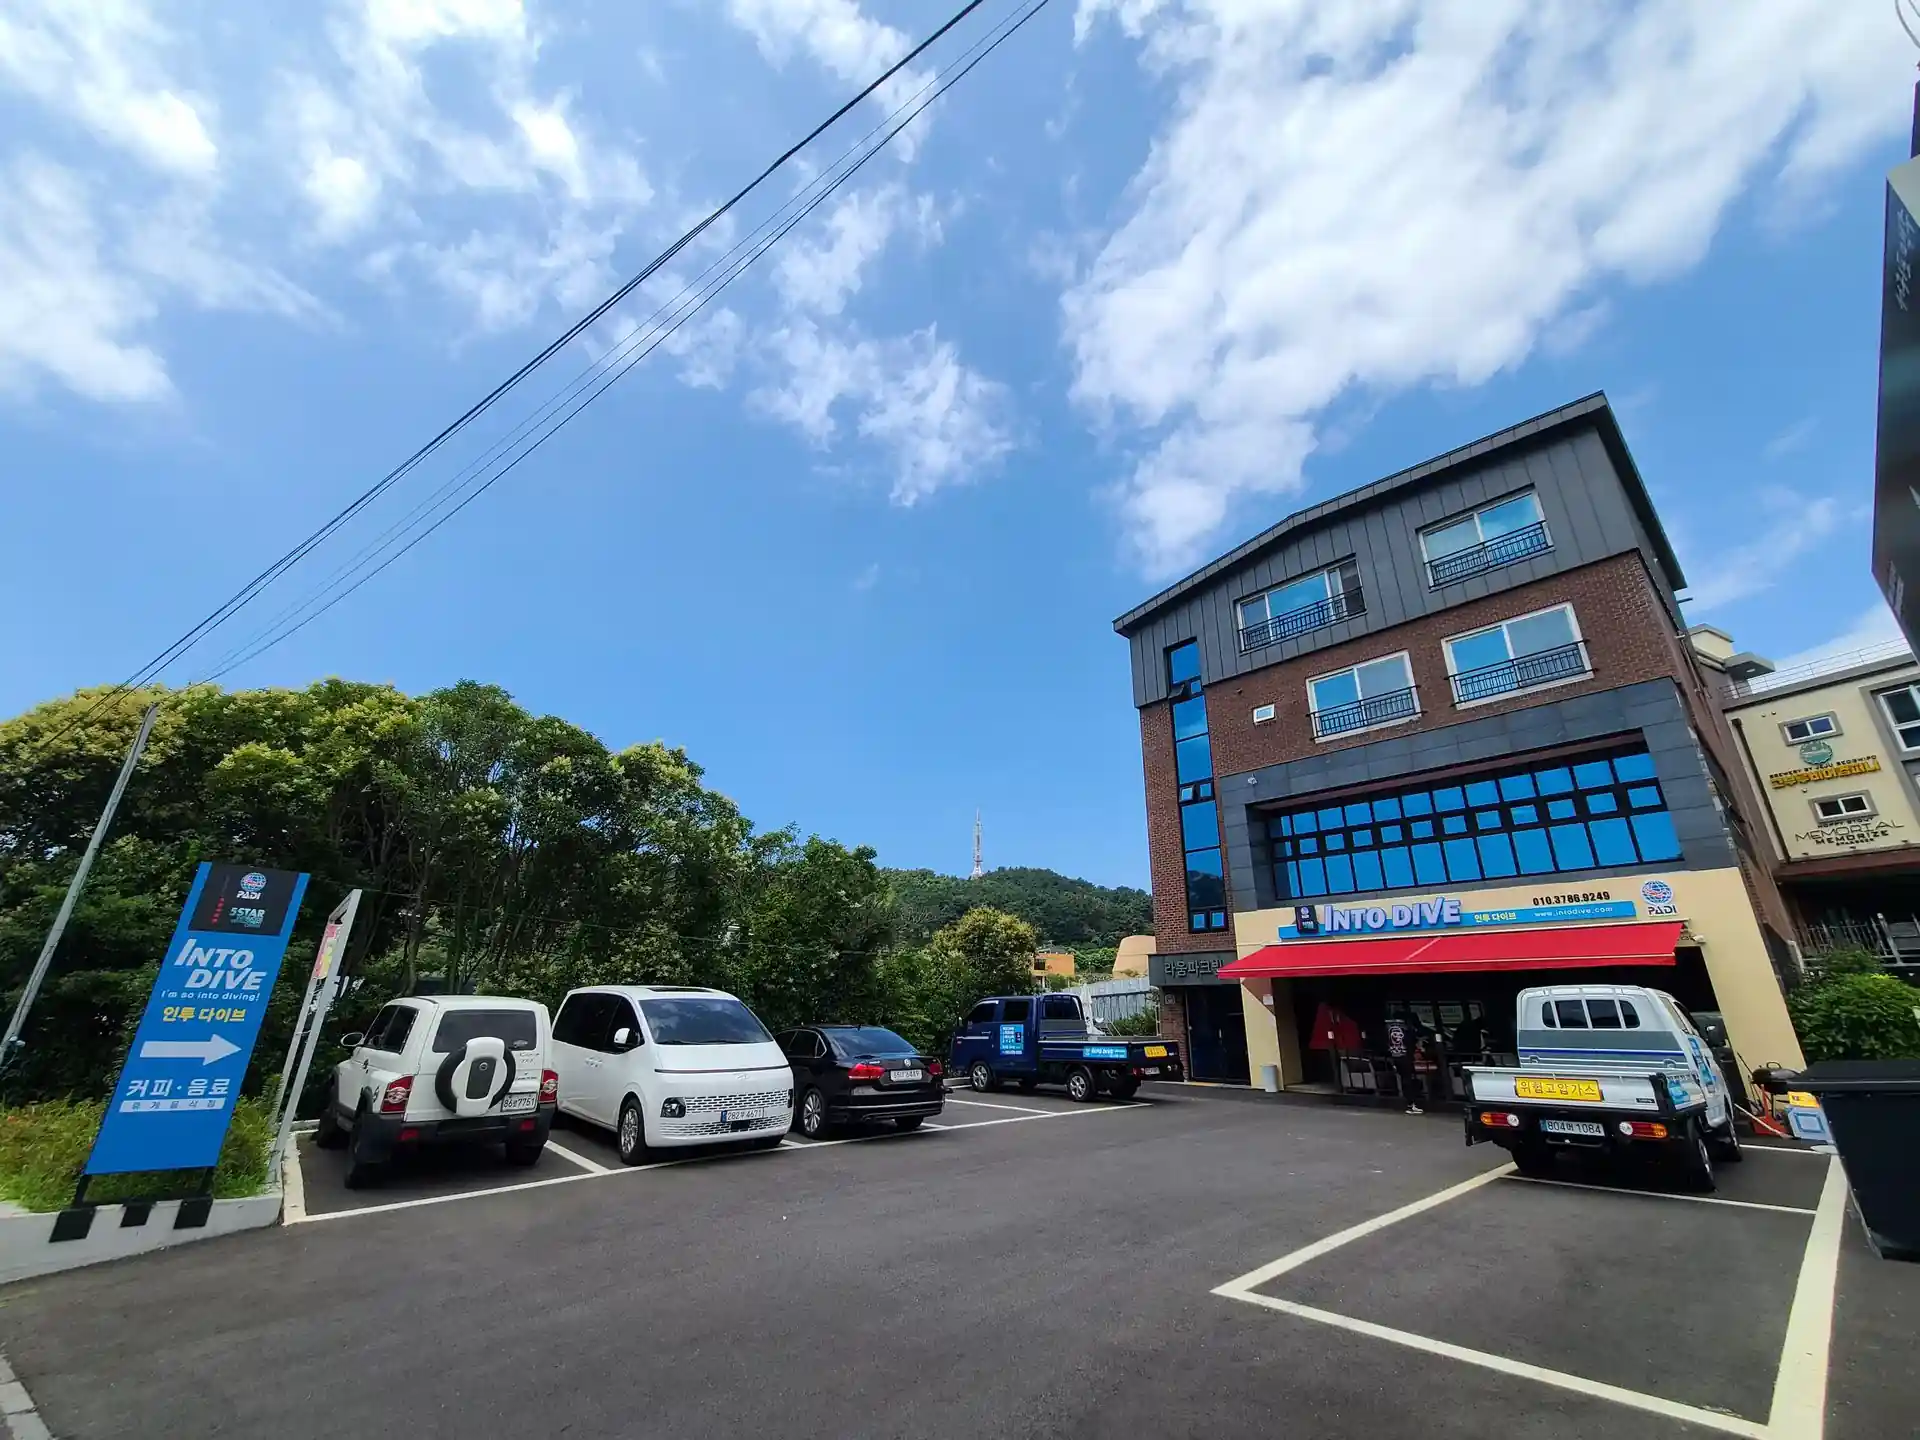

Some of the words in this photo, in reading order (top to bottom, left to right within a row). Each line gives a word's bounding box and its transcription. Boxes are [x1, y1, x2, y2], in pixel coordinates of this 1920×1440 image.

[1795, 820, 1904, 841] MEMORIAL
[1815, 830, 1889, 844] MEMORIZE
[236, 890, 261, 900] PADI
[1532, 892, 1610, 906] 010.3786.9249
[1324, 904, 1386, 932] INTO
[1392, 896, 1461, 928] DIVE
[1648, 904, 1676, 915] PADI
[174, 938, 254, 969] INTO
[184, 968, 268, 990] DIVE
[197, 992, 220, 1000] into
[222, 992, 261, 1002] diving!
[163, 1006, 196, 1022] 인투
[198, 1007, 246, 1022] 다이브
[1576, 1124, 1601, 1134] 1084
